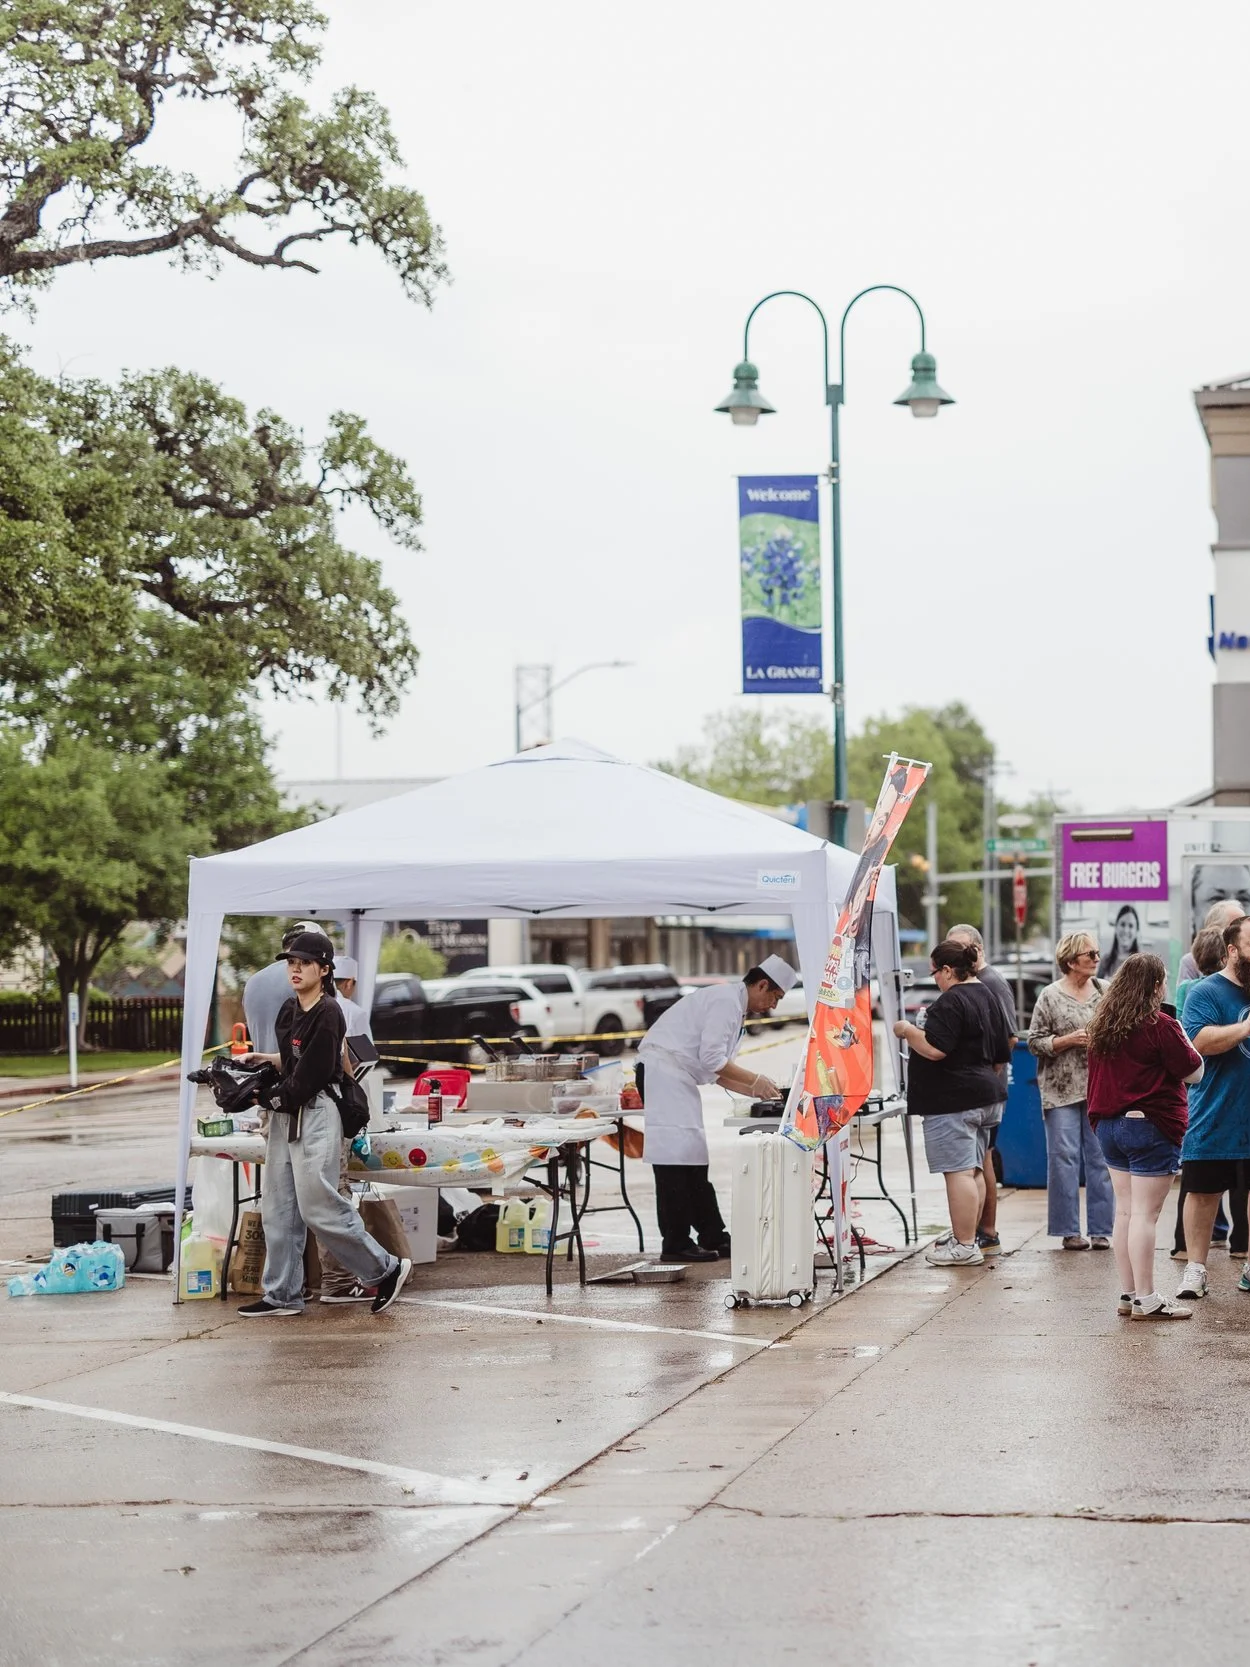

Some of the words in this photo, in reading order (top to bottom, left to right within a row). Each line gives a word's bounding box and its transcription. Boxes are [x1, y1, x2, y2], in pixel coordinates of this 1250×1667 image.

[747, 488, 811, 502] Welcome
[746, 666, 765, 680] LA
[766, 665, 820, 680] GRANGE
[1070, 862, 1100, 888] FREE
[1102, 861, 1161, 888] BURGERS
